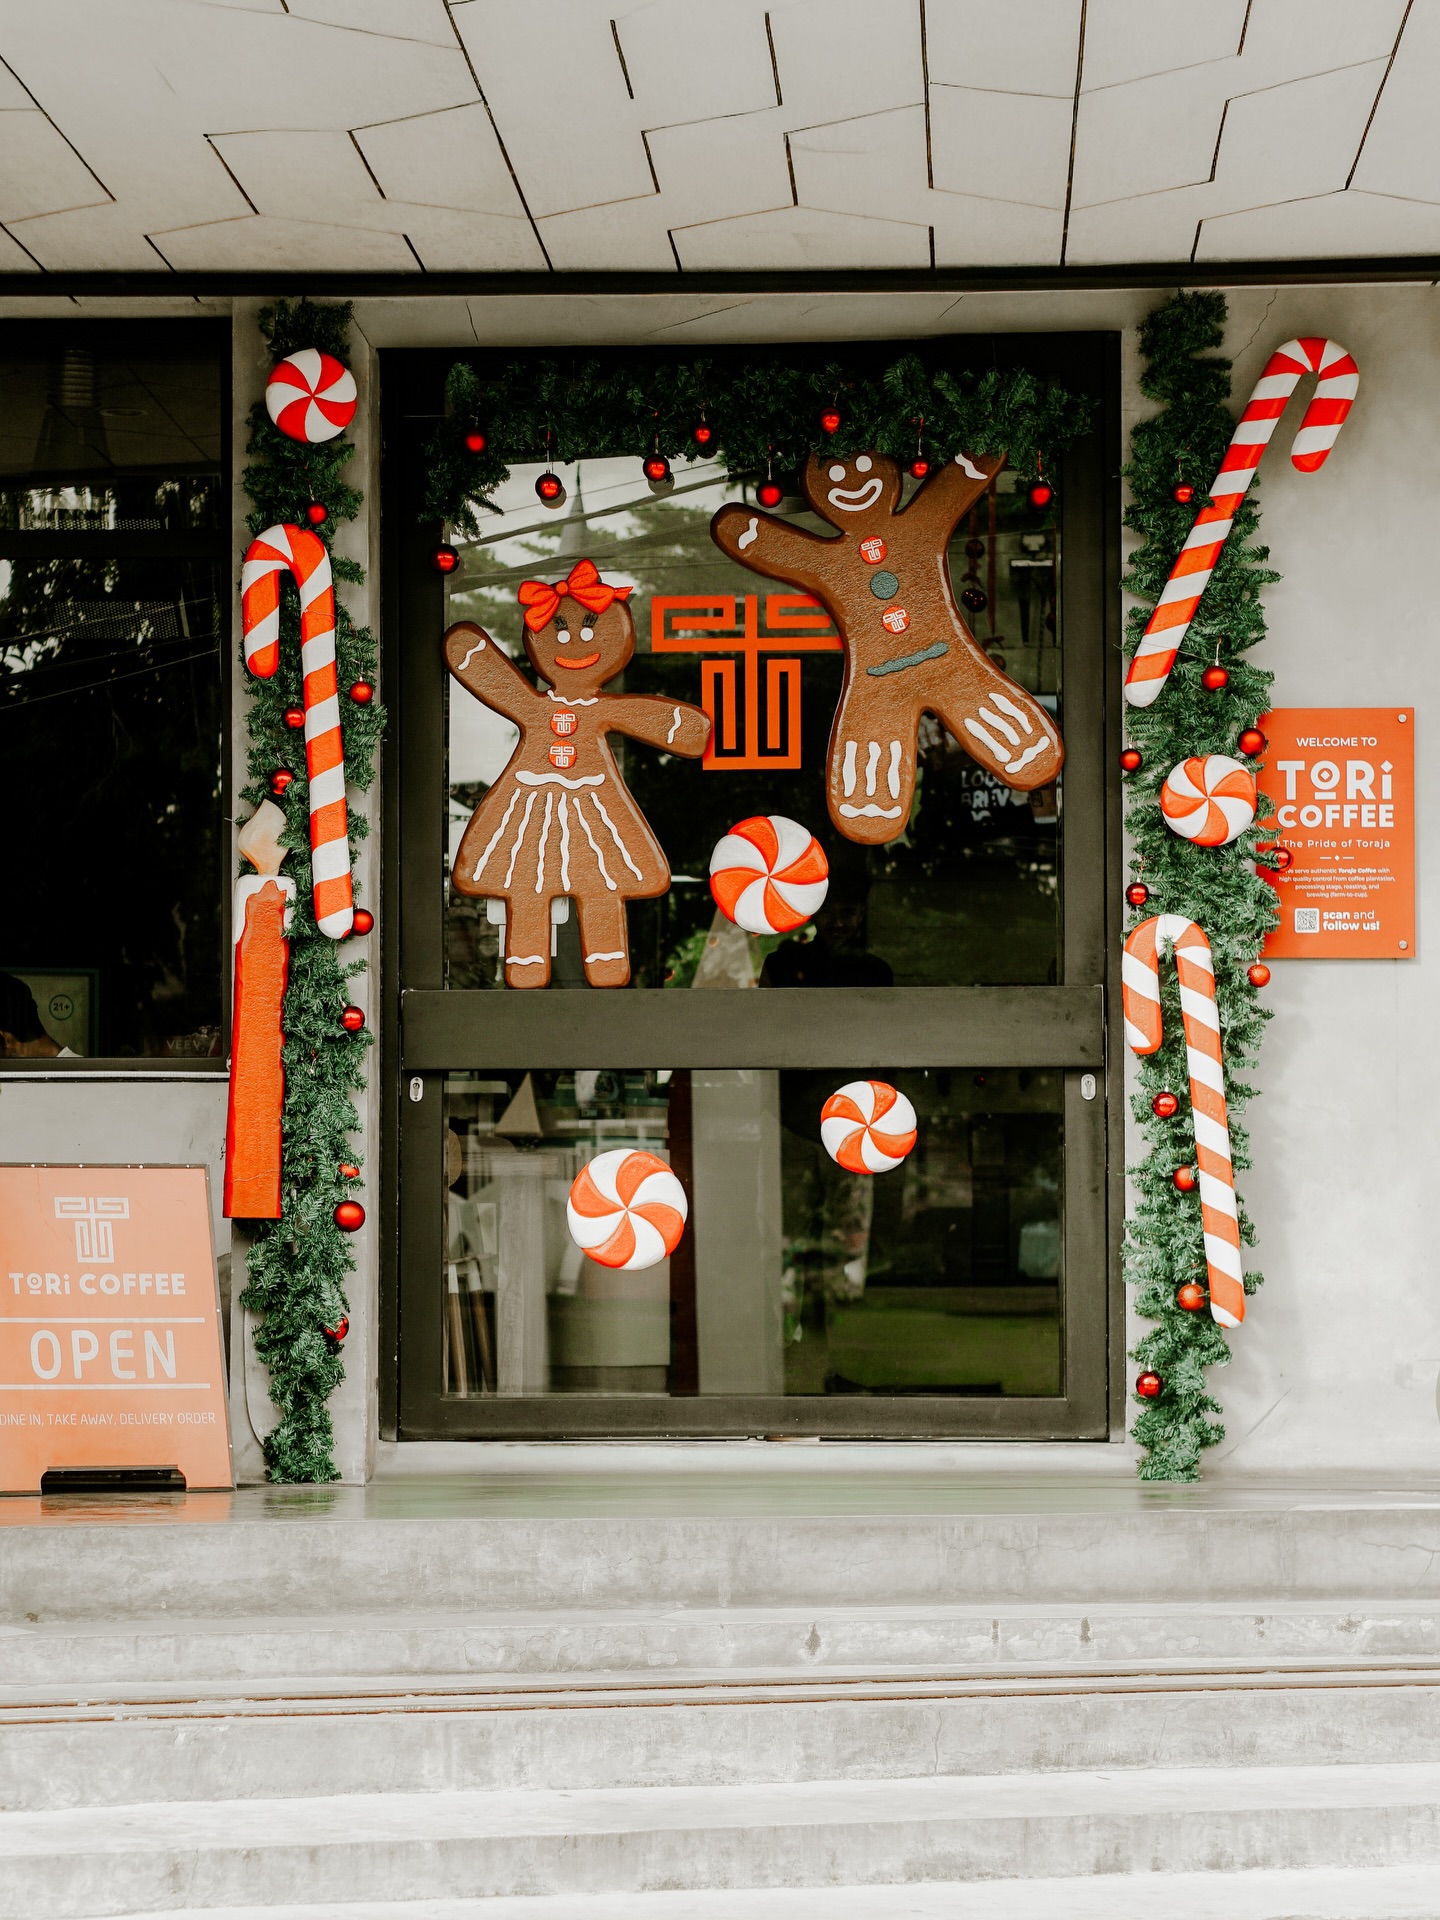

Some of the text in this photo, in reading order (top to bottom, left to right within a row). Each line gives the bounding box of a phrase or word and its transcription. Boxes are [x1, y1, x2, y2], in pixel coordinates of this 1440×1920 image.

[1296, 737, 1377, 748] WELCOME TO
[1277, 804, 1394, 828] COFFEE
[1283, 839, 1391, 849] The Pride of Toraja
[1323, 910, 1375, 920] scan and
[1323, 920, 1380, 931] follow us!
[53, 1003, 69, 1011] 21+
[79, 1273, 186, 1295] COFFEE
[30, 1330, 177, 1379] OPEN
[0, 1412, 216, 1427] DINE IN, TAKE AWAY, DELIVERY ORDER
